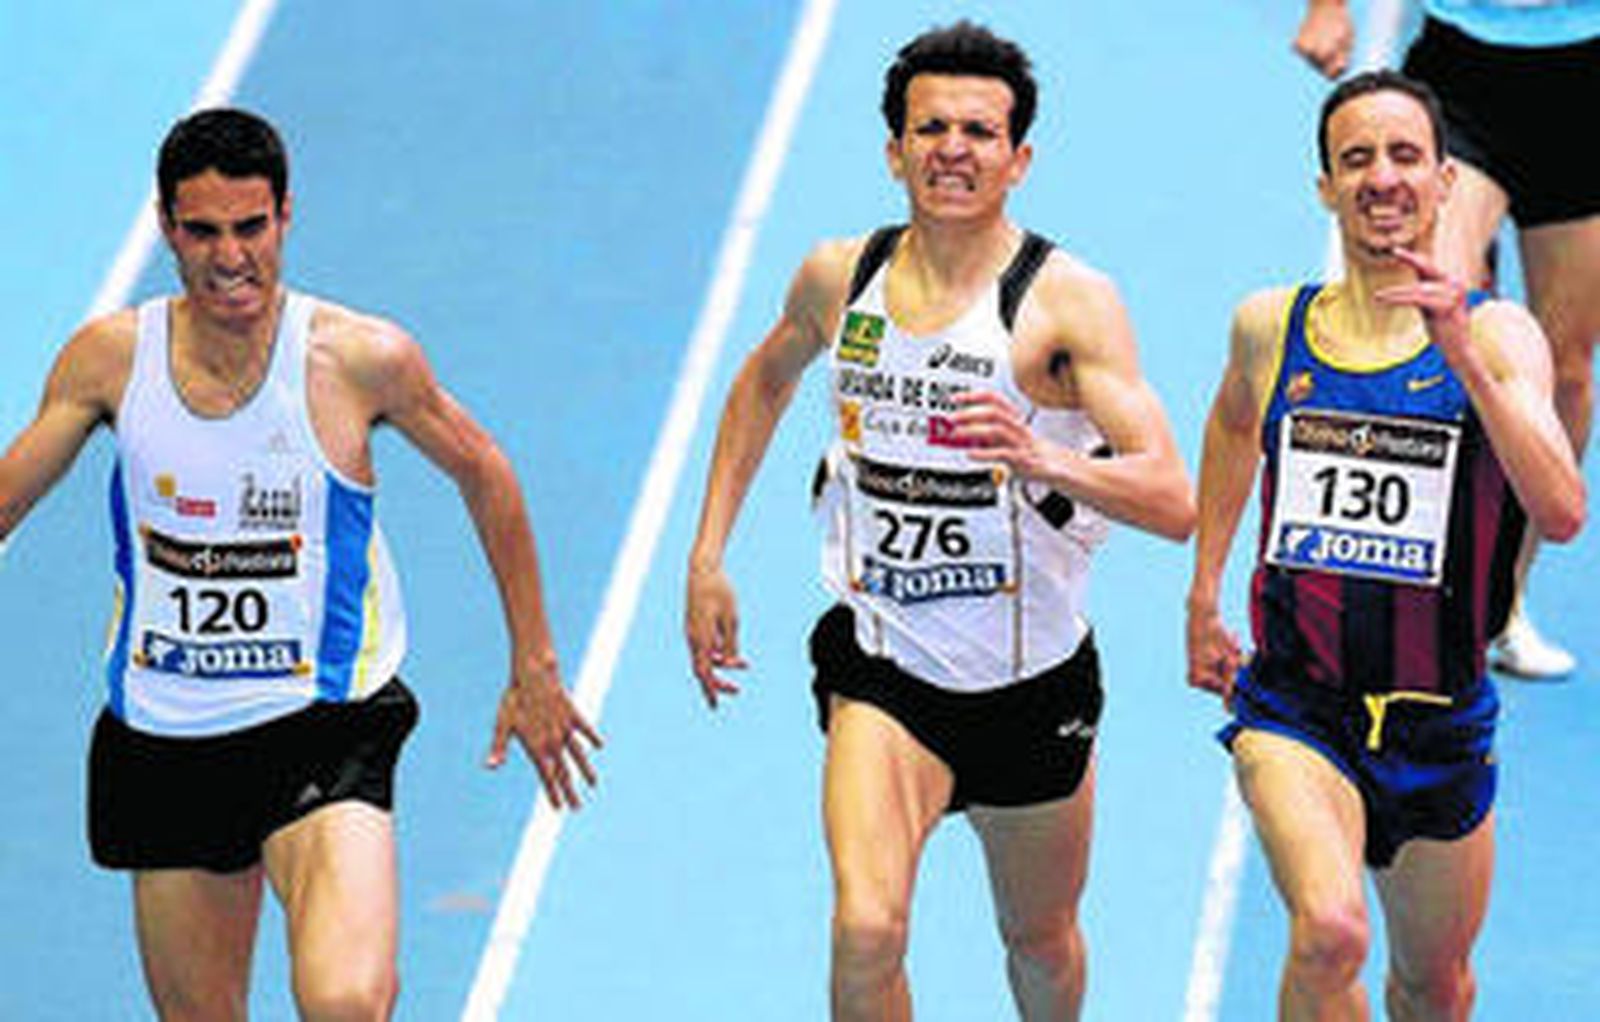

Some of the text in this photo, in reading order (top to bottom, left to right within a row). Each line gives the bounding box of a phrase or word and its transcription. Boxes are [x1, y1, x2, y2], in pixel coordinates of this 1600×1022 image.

[902, 377, 923, 407] DE
[1314, 466, 1411, 525] 130
[874, 508, 971, 560] 276
[169, 586, 268, 634] 120
